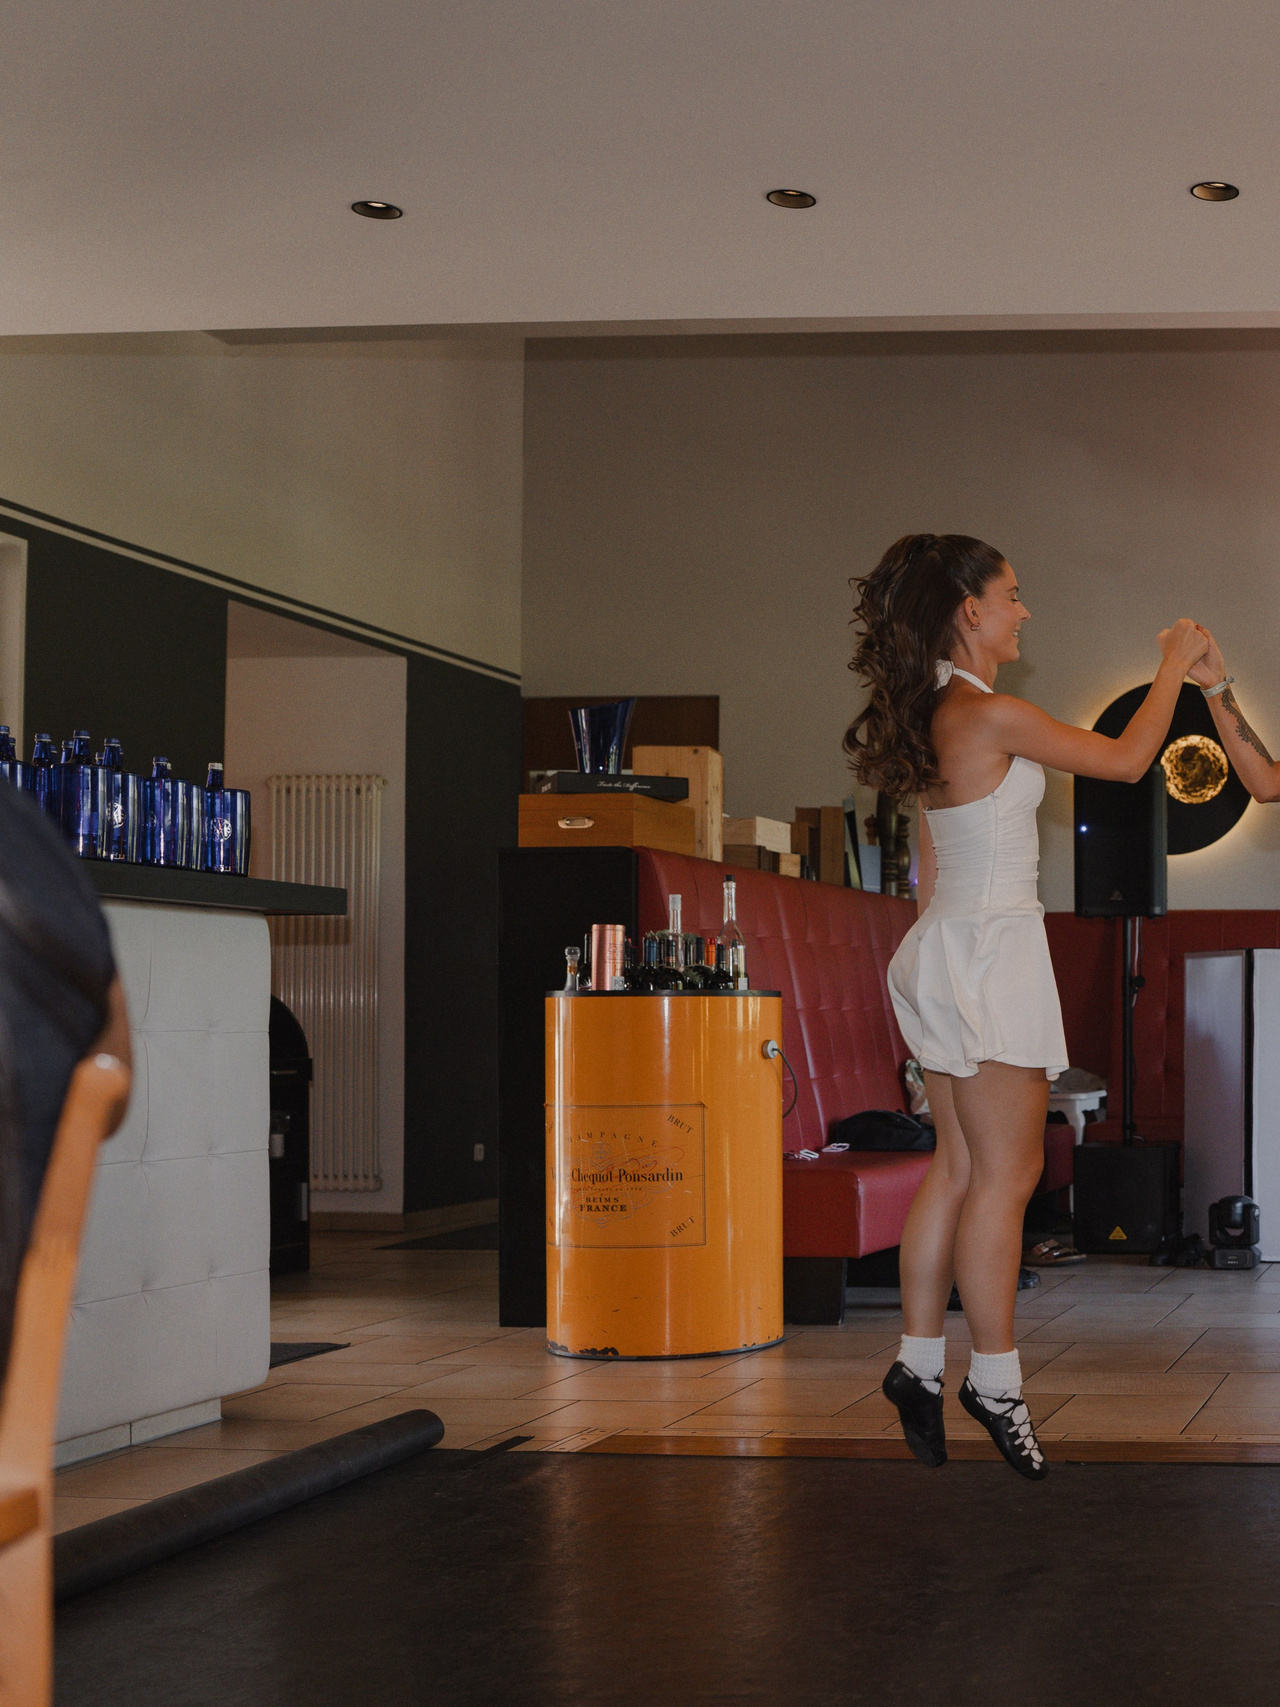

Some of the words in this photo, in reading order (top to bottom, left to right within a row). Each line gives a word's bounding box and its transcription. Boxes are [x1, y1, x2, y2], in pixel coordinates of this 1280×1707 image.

[667, 1114, 694, 1134] BRUT
[567, 1131, 658, 1148] HAMPAGNE
[618, 1166, 683, 1182] Ponsardin
[585, 1196, 620, 1204] REIMS
[579, 1204, 628, 1213] FRANCE
[670, 1215, 695, 1238] BRUT
